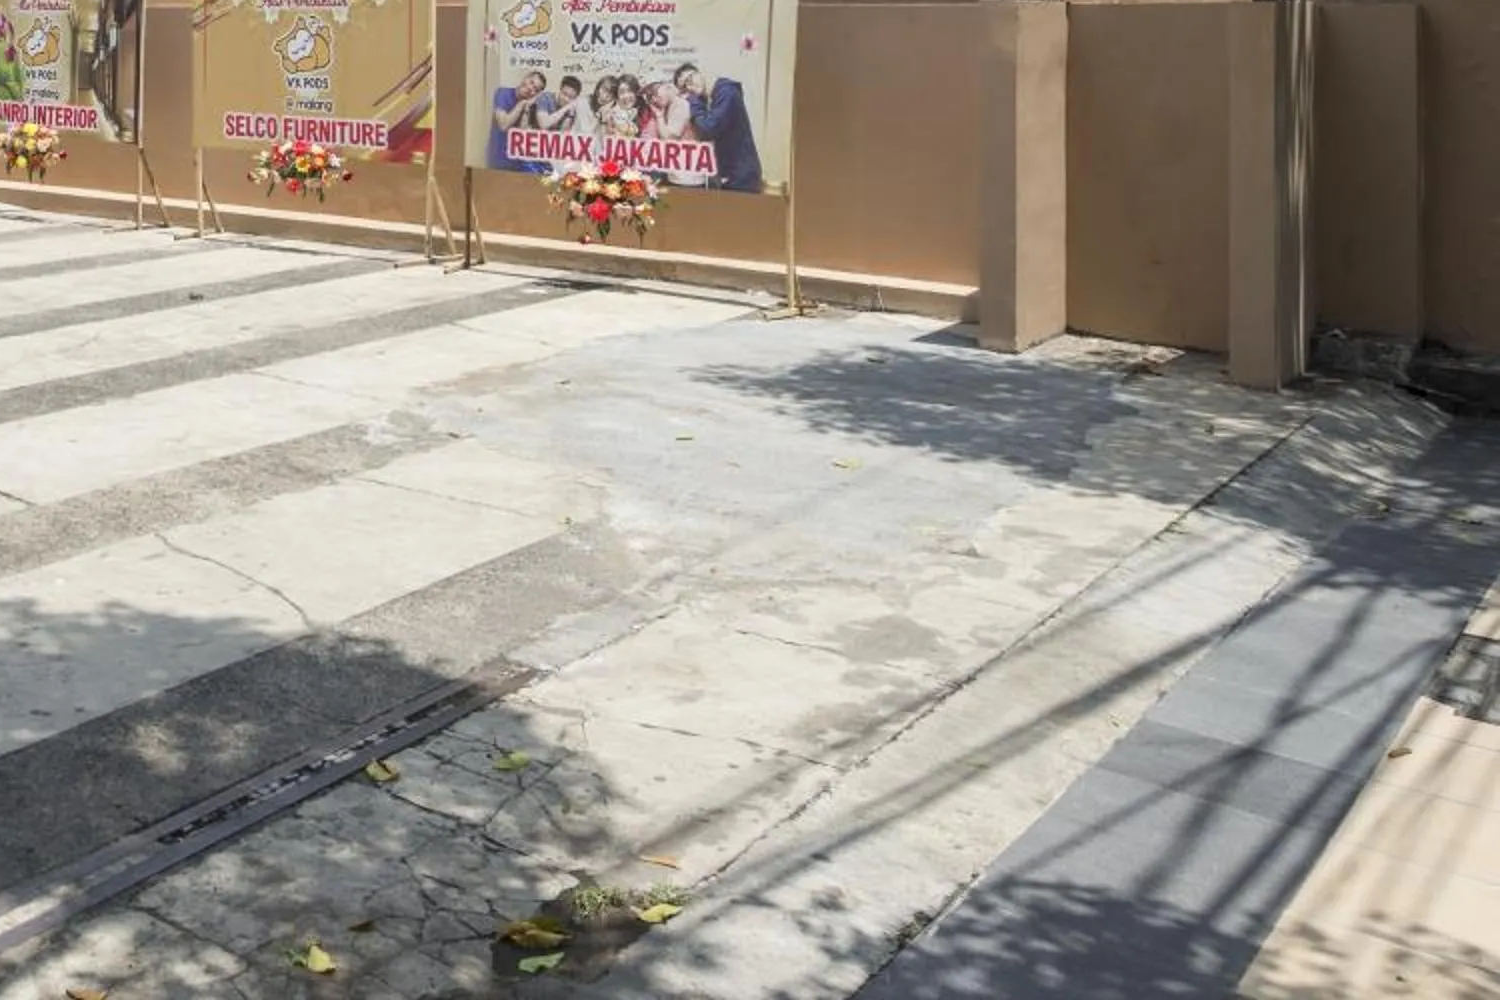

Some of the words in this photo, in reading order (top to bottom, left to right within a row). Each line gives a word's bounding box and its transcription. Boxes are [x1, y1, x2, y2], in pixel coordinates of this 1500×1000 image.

[569, 22, 605, 45] VK
[611, 23, 669, 47] PODS
[33, 106, 98, 128] INTERIOR
[226, 115, 277, 138] SELCO
[283, 118, 386, 147] FURNITURE
[510, 131, 593, 162] REMAX
[599, 139, 714, 173] JAKARTA
